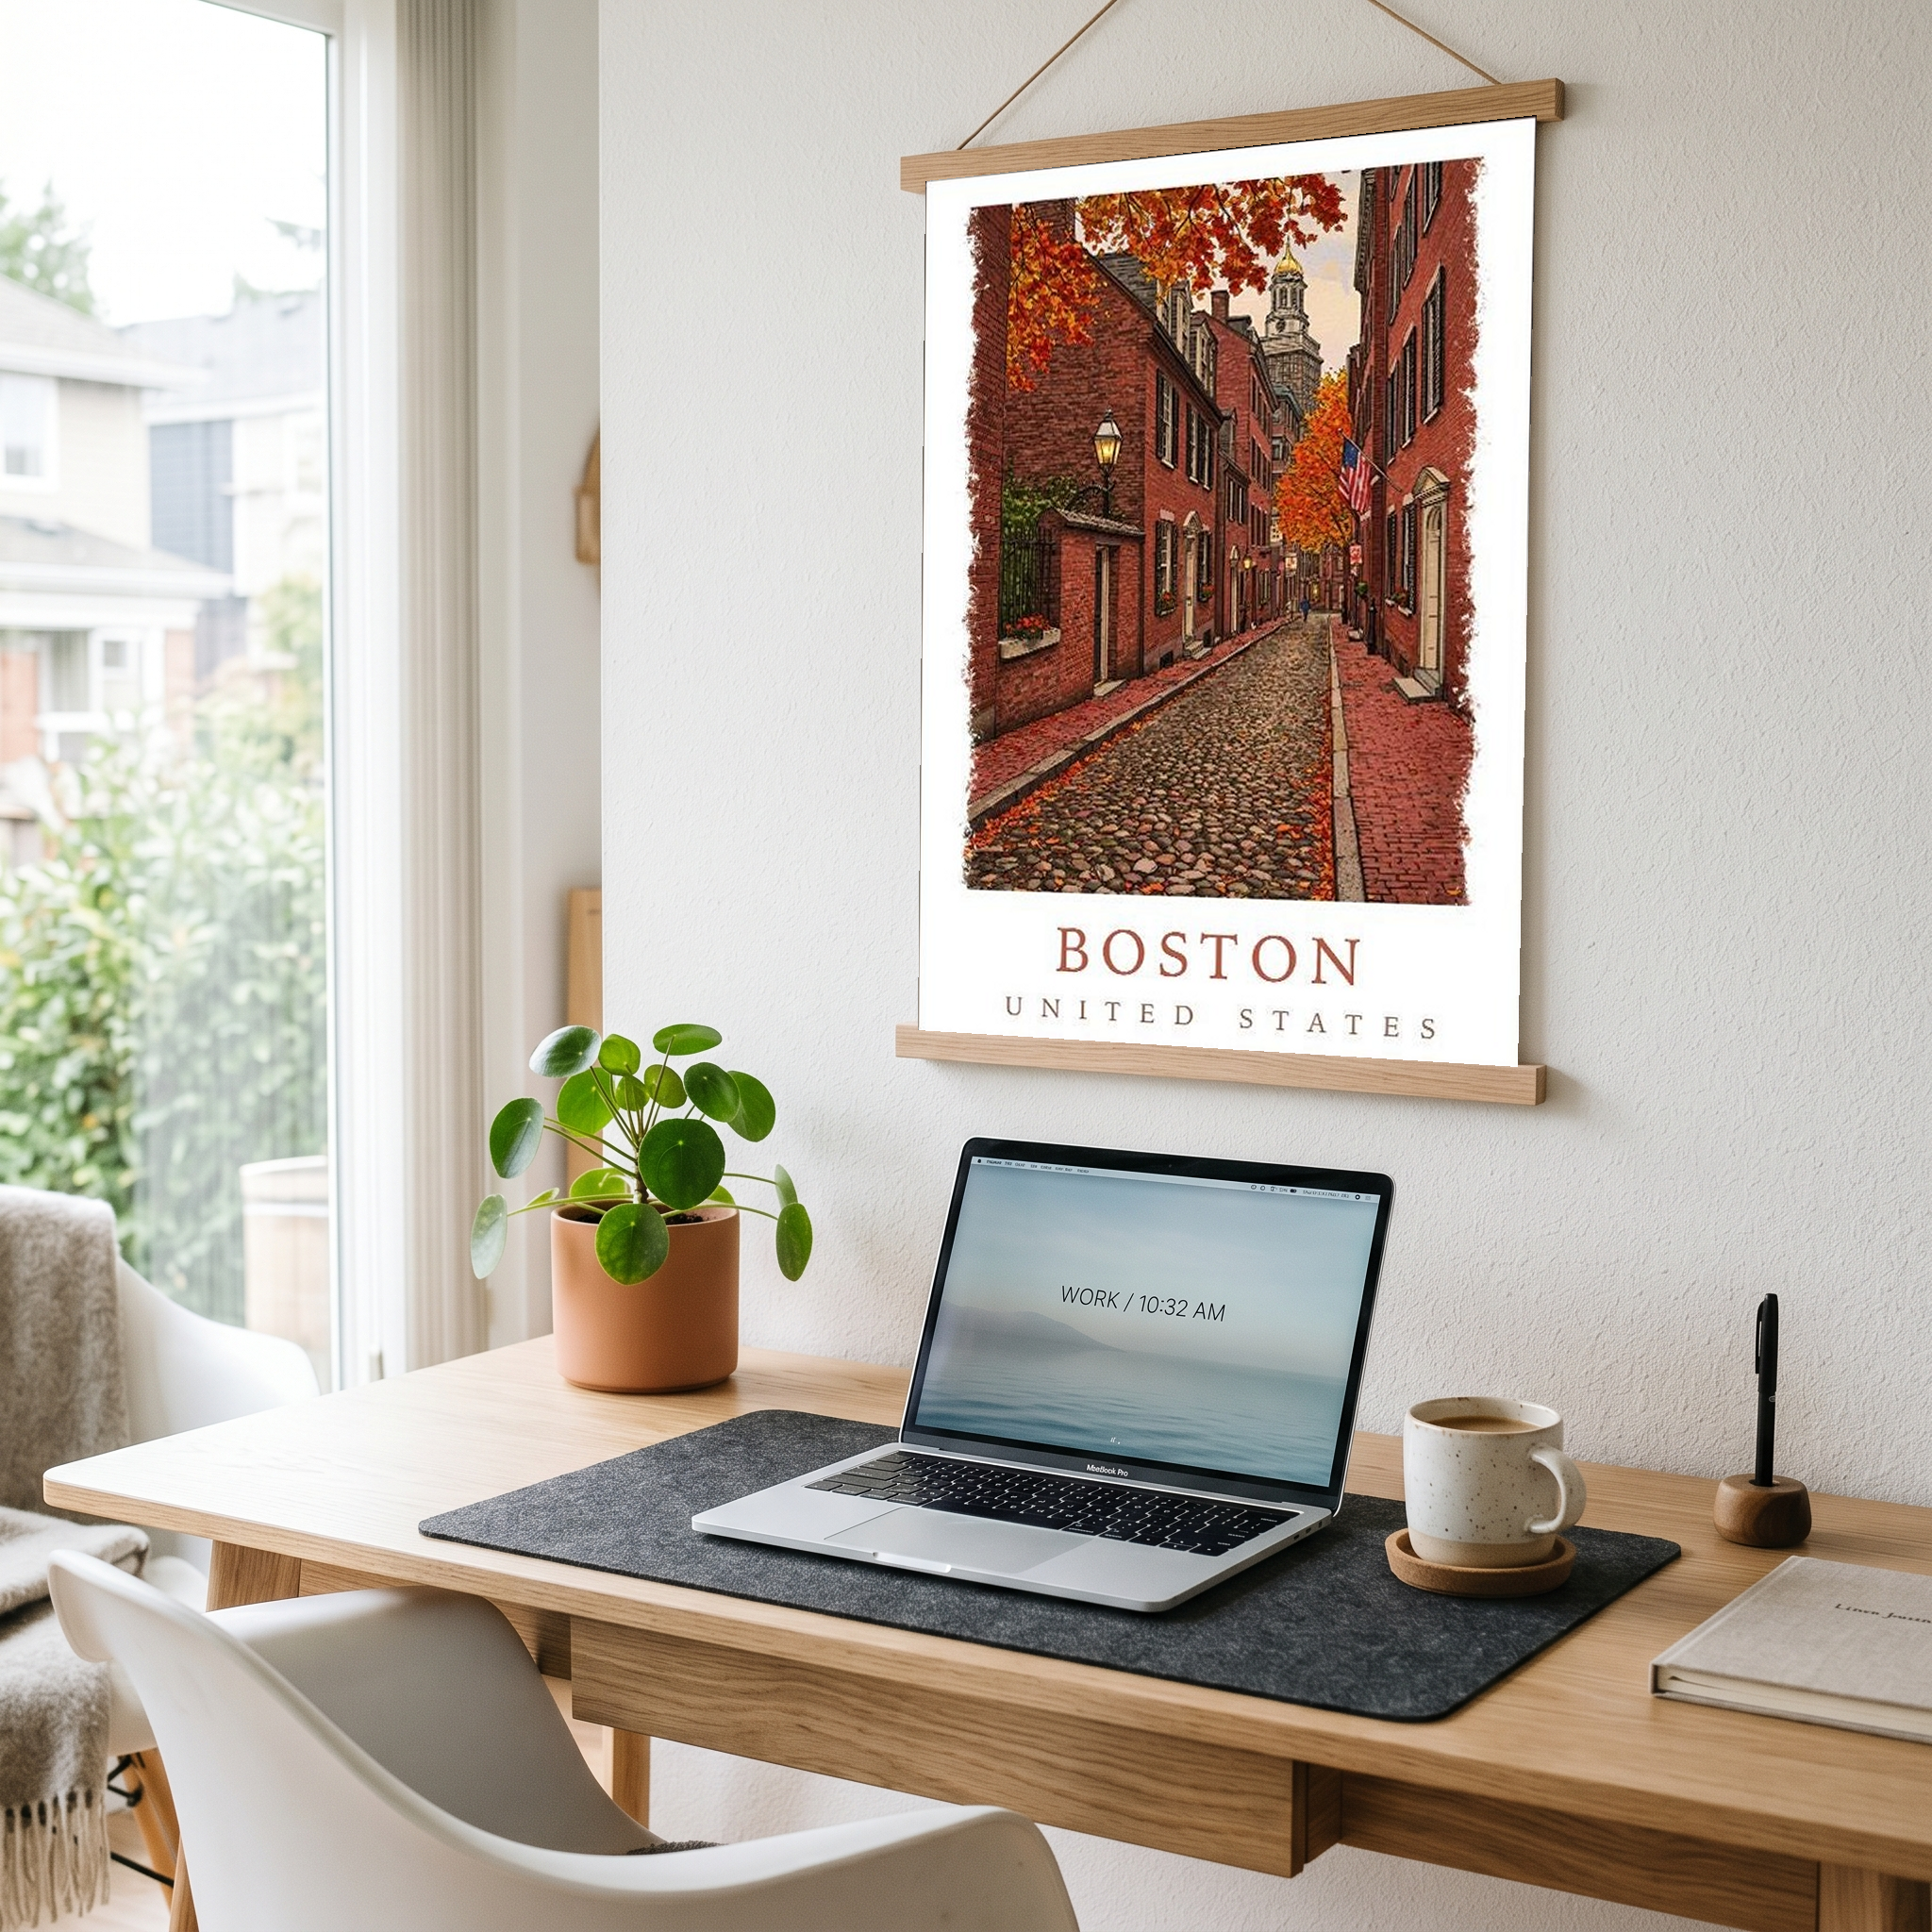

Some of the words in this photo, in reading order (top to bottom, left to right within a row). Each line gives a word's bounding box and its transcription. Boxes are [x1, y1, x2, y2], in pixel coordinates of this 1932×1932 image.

[1056, 926, 1361, 987] BOSTON
[1005, 995, 1195, 1026] UNITED
[1239, 1008, 1436, 1040] STATES
[1061, 1285, 1121, 1309] WORK
[1139, 1294, 1189, 1318] 10:32
[1192, 1301, 1226, 1322] AM
[1117, 1468, 1129, 1477] Pro
